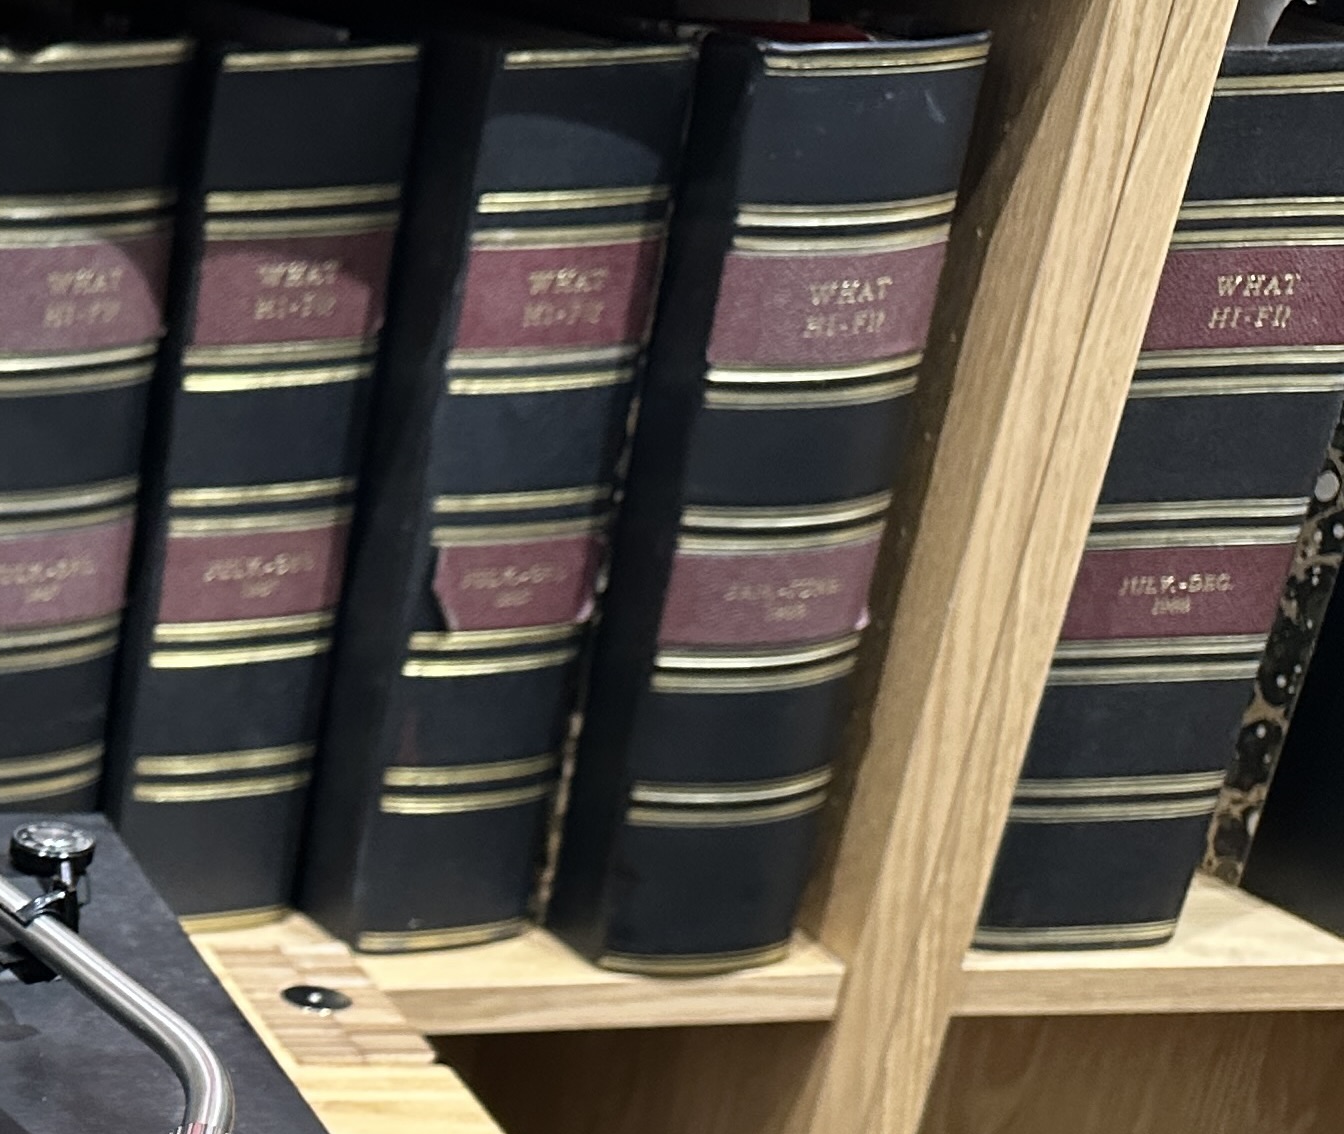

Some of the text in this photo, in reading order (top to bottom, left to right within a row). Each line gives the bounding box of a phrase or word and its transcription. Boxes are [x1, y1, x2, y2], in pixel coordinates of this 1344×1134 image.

[528, 268, 608, 295] WHAT
[808, 276, 894, 305] WHAT
[1217, 274, 1301, 296] WHAT
